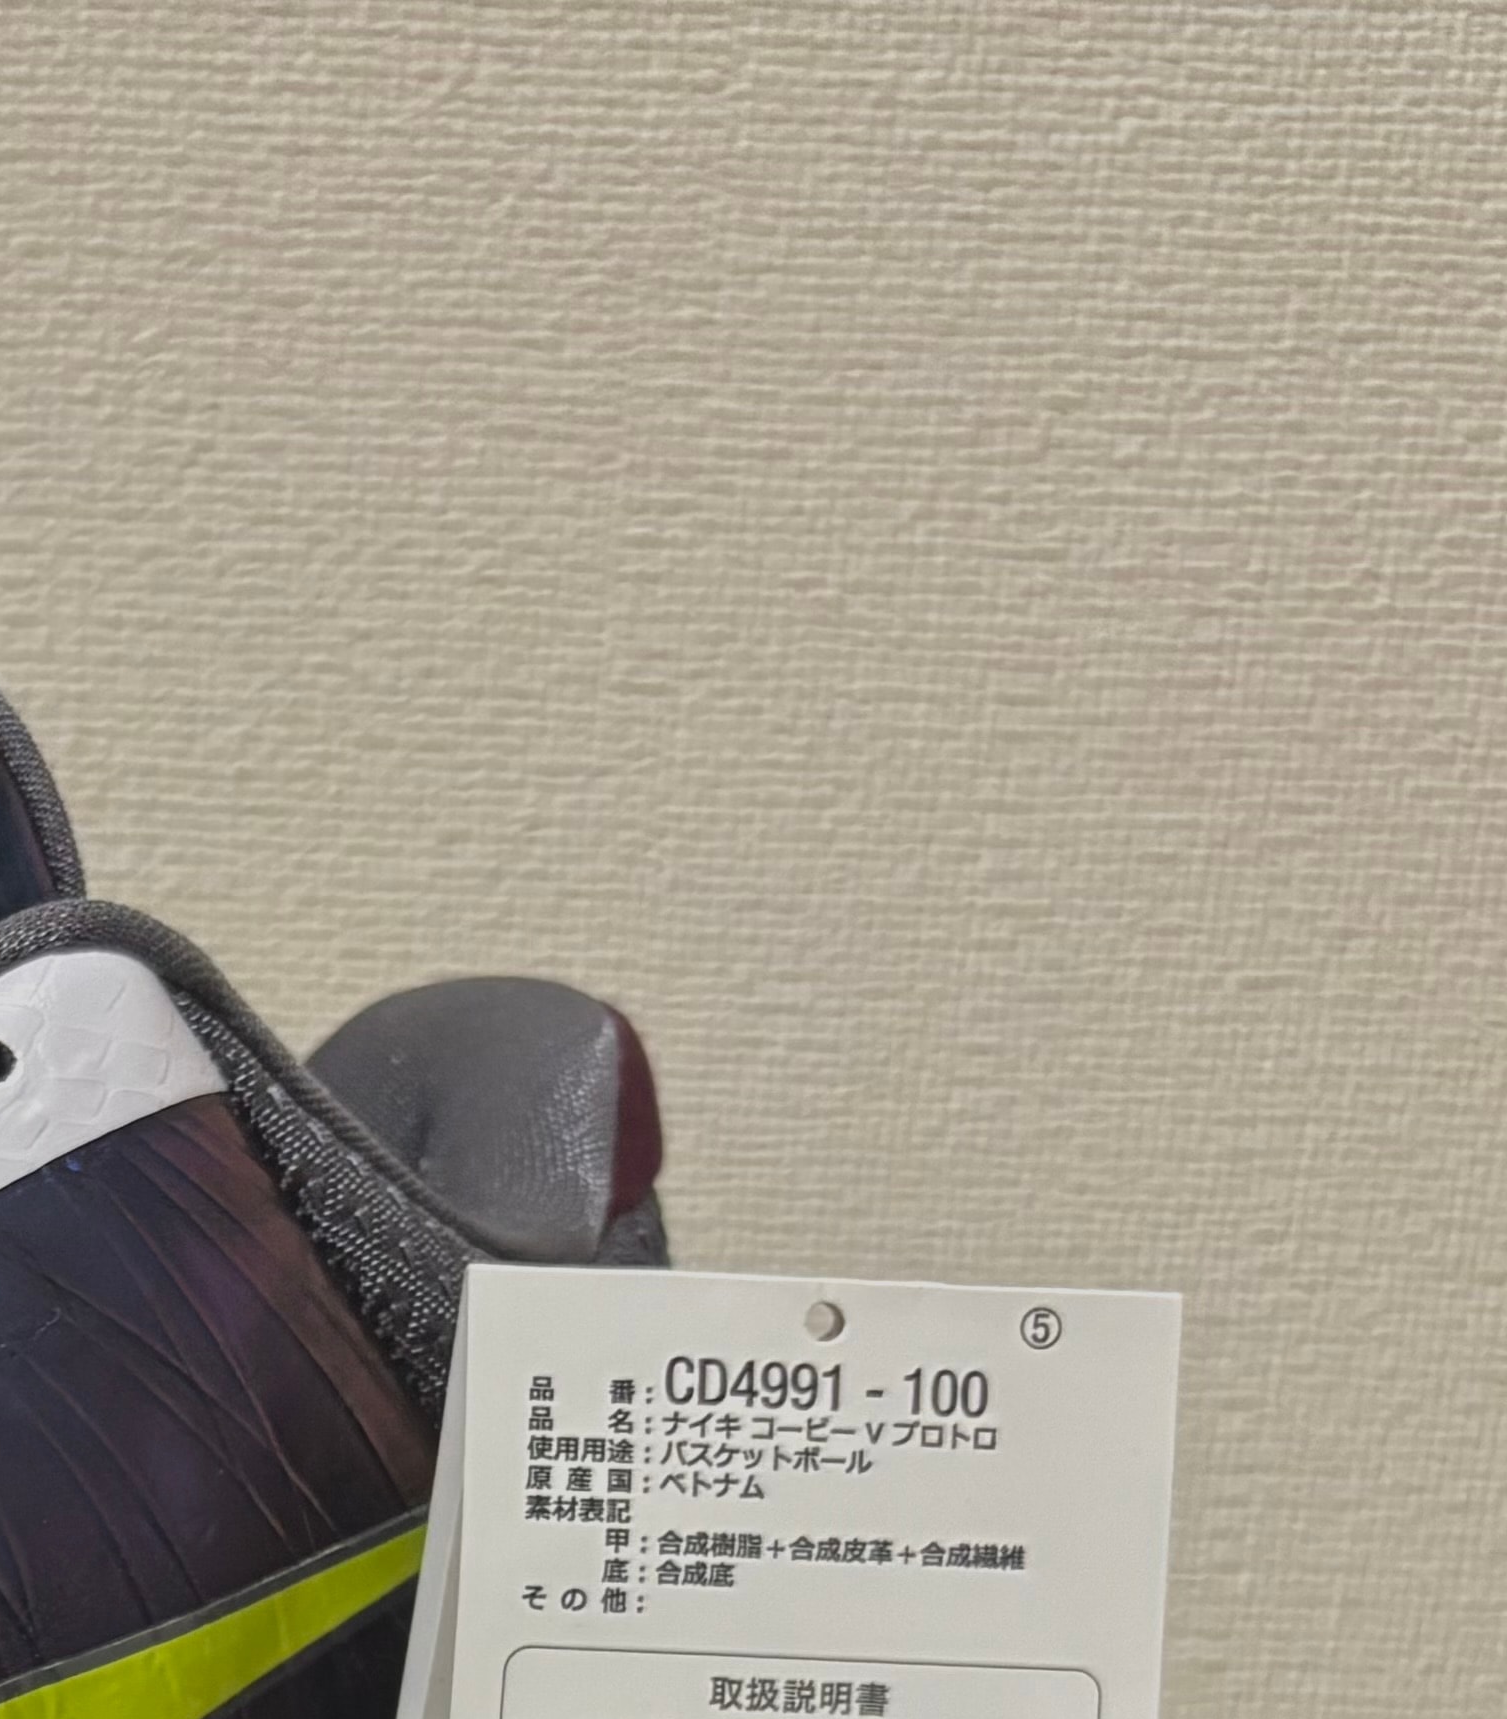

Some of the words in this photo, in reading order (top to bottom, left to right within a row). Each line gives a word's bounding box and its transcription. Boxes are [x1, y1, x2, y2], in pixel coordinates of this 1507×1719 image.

[664, 1356, 843, 1411] CD4991
[903, 1367, 989, 1418] 100
[661, 1410, 742, 1440] ナイキ
[751, 1416, 856, 1444] コービー
[890, 1420, 998, 1452] プロトロ
[524, 1494, 632, 1524] 素材表記
[708, 1675, 891, 1718] 取扱説明書
